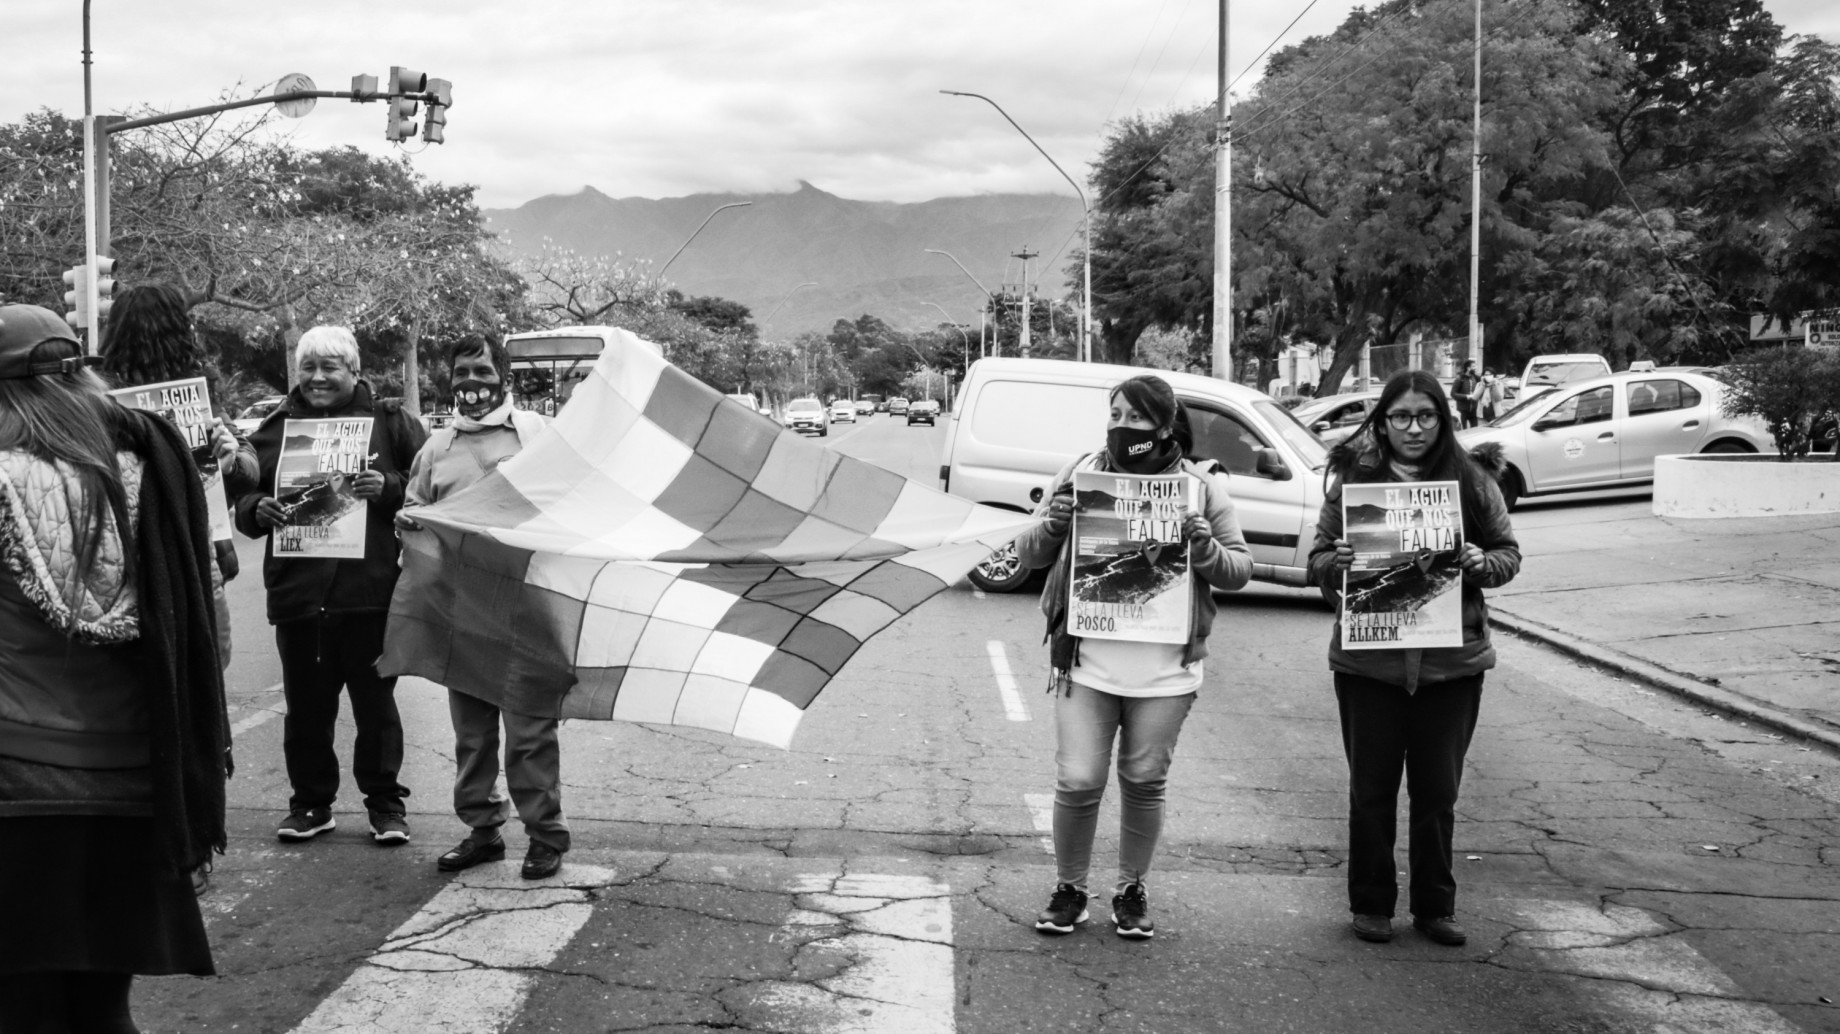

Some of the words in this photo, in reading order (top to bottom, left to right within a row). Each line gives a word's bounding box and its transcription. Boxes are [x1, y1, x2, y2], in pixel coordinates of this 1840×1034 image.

[135, 391, 156, 410] EL
[160, 385, 201, 408] AGUA
[173, 404, 204, 425] NOS
[316, 423, 329, 438] EL
[334, 422, 366, 437] AGUA
[312, 438, 335, 455] QUE
[337, 437, 361, 453] NOS
[1128, 440, 1153, 453] UPND
[320, 453, 359, 472] FALTA
[1115, 478, 1134, 499] EL
[1139, 480, 1181, 499] AGUA
[1384, 488, 1405, 508] EL
[1409, 487, 1451, 506] AGUA
[1114, 498, 1143, 519] QUE
[1150, 500, 1181, 520] NOS
[1385, 509, 1415, 531] QUE
[1421, 507, 1453, 528] NOS
[280, 526, 291, 538] SE
[292, 526, 302, 538] LA
[304, 526, 329, 539] LLEVA
[1129, 520, 1180, 541] FALTA
[1402, 528, 1454, 551] FALTA
[1077, 601, 1090, 617] SE
[1094, 602, 1108, 618] LA
[1111, 603, 1144, 620] LLEVA
[1350, 613, 1363, 628] SE
[1367, 613, 1381, 628] LA
[1384, 612, 1418, 628] LLEVA
[1076, 615, 1118, 633] POSCO.
[1349, 626, 1403, 642] ALLKEM.
